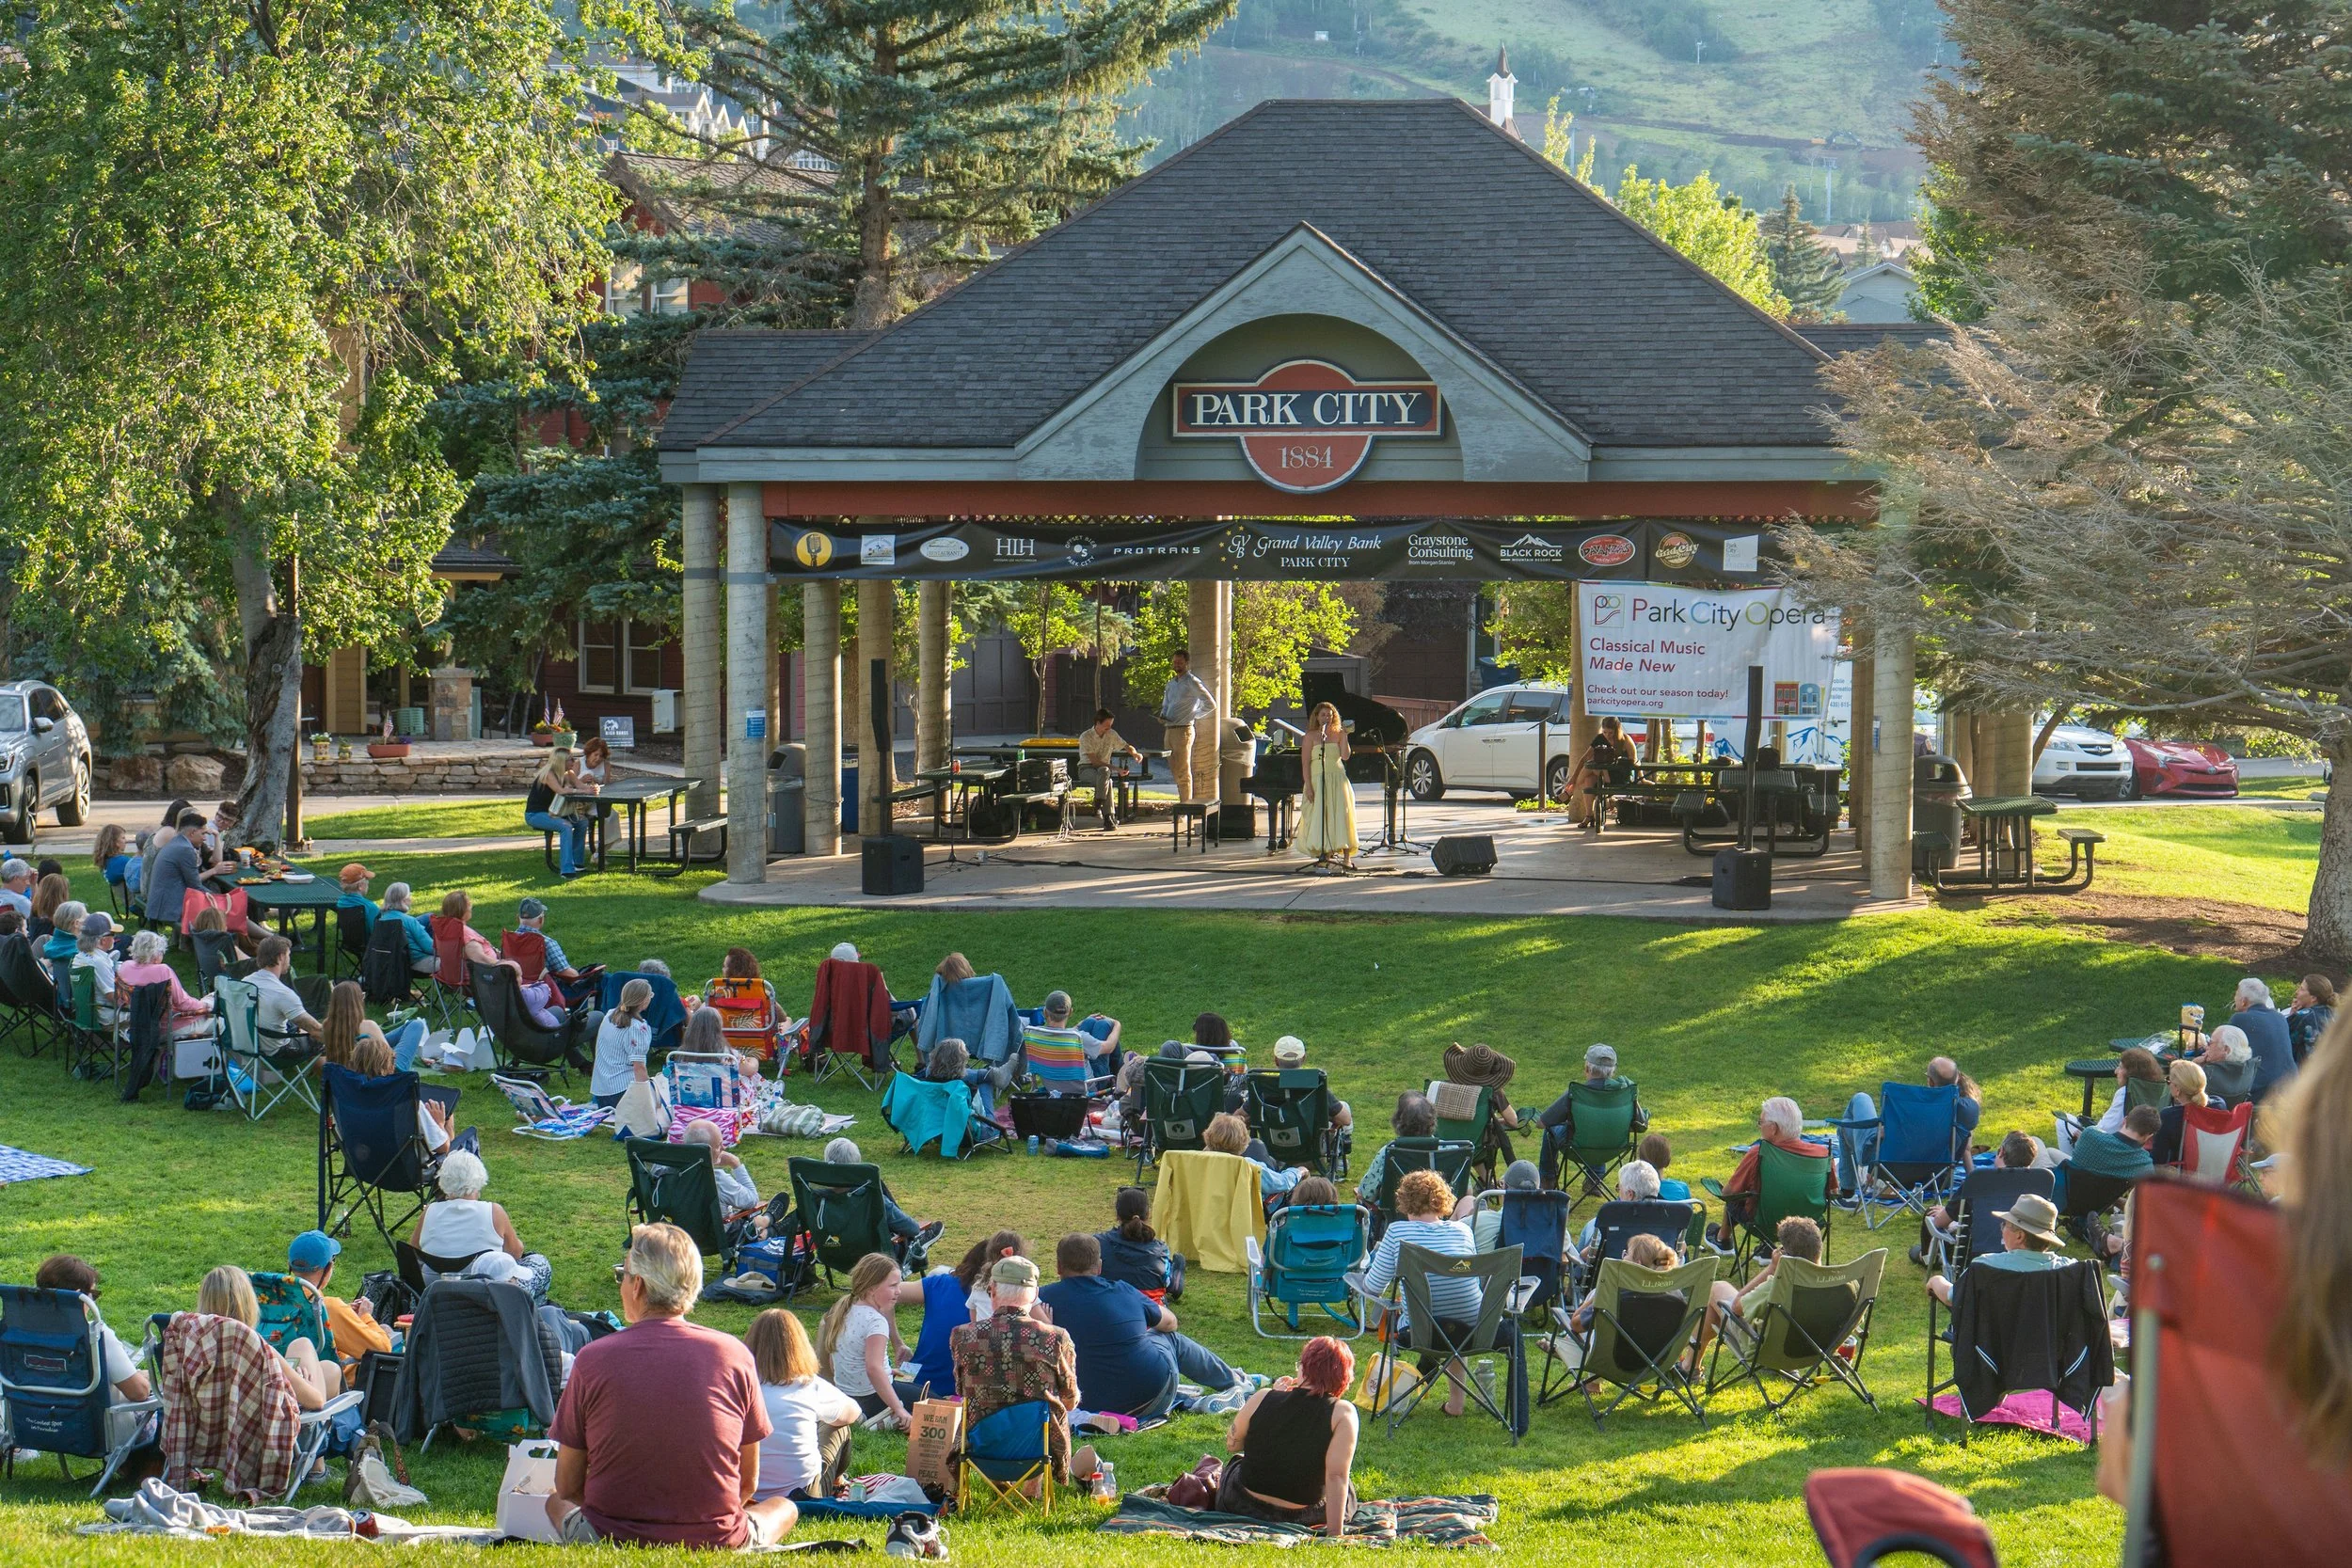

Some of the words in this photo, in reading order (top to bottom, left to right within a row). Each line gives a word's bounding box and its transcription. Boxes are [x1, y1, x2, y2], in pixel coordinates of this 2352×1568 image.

[1190, 393, 1303, 426] PARK
[1312, 391, 1422, 425] CITY
[1278, 445, 1334, 469] 1884
[995, 537, 1036, 556] HLH
[1064, 535, 1084, 549] OFFSET
[1084, 536, 1098, 549] BIER
[1253, 534, 1299, 559] Grand
[1305, 534, 1343, 554] Valley
[1347, 535, 1382, 550] Bank
[1407, 533, 1469, 548] Graystone
[1113, 546, 1201, 555] PROTRANS
[1407, 546, 1474, 561] Consulting
[1500, 548, 1533, 557] BLACK
[1534, 548, 1563, 557] ROCK
[1655, 546, 1677, 558] Grid
[1677, 543, 1700, 555] City
[1066, 555, 1079, 567] PARK
[1080, 555, 1095, 567] CITY
[1279, 557, 1315, 567] PARK
[1317, 557, 1351, 567] CITY
[1632, 598, 1687, 624] Park
[1690, 600, 1741, 631] City
[1745, 601, 1826, 631] Opera
[1589, 637, 1655, 654] Classical
[1660, 641, 1706, 656] Music
[1589, 657, 1633, 672] Made
[1639, 658, 1677, 673] New
[1587, 684, 1619, 696] Check
[1620, 686, 1638, 696] out
[1640, 688, 1658, 697] our
[1660, 689, 1694, 698] season
[1696, 689, 1729, 700] today!
[1587, 697, 1664, 708] parkcityopera.org
[923, 1414, 935, 1422] WE
[935, 1415, 948, 1424] BAN
[920, 1426, 946, 1440] 300
[918, 1469, 939, 1480] PEACE
